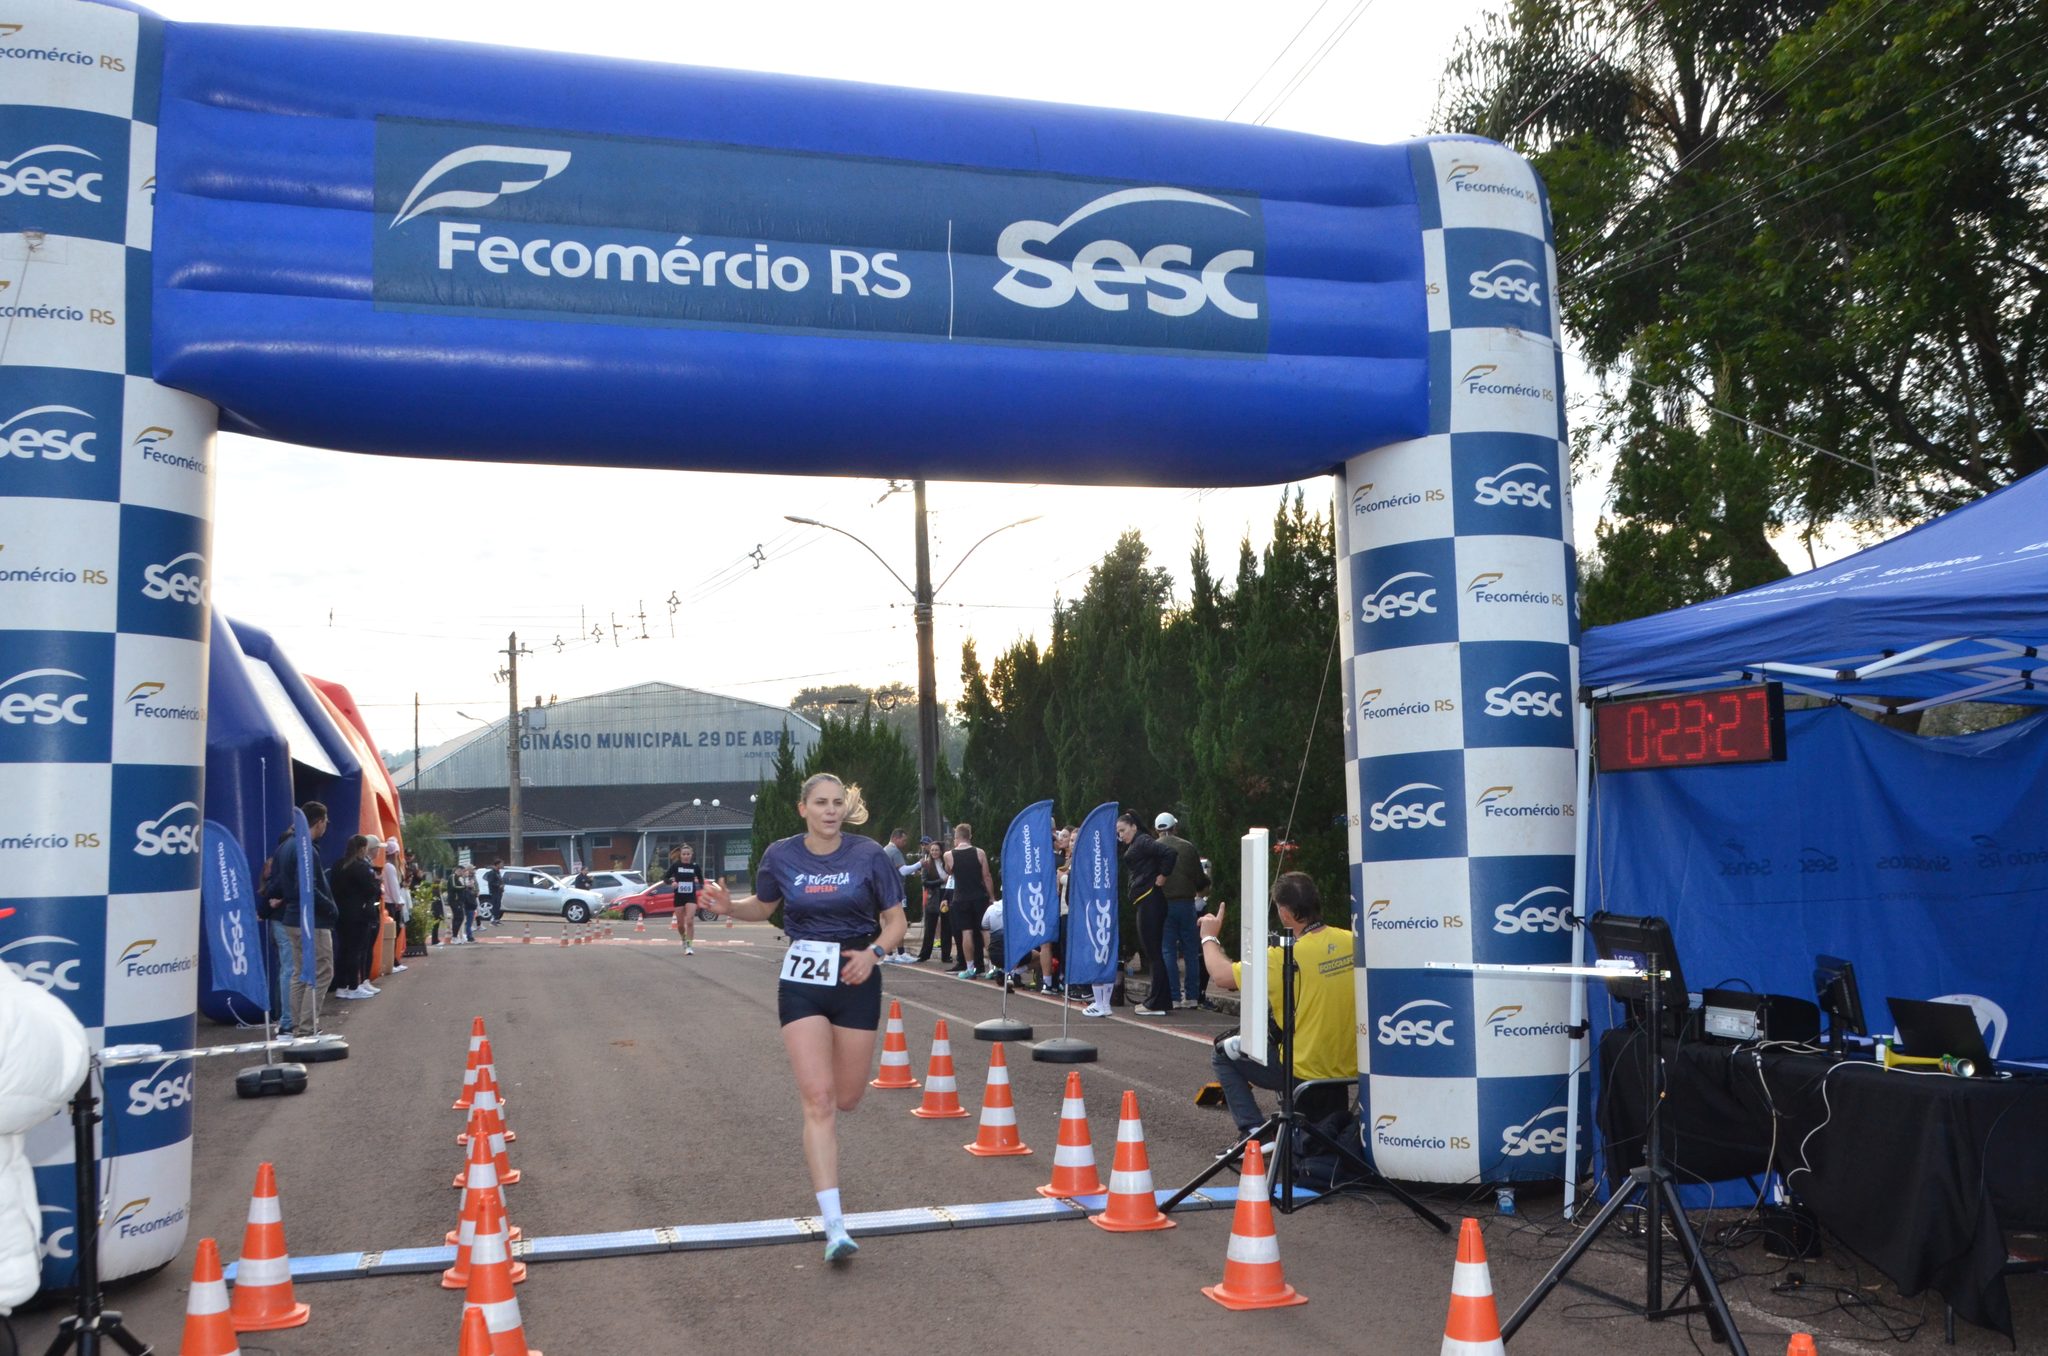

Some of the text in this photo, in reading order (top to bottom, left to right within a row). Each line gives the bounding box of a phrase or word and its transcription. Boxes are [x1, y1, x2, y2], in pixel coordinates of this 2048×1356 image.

[0, 47, 126, 72] ecomércio RS
[1455, 180, 1538, 204] Fecomércio RS
[439, 222, 912, 300] Fecomércio RS
[992, 218, 1260, 320] Sesc
[1469, 269, 1542, 307] Sesc
[0, 303, 116, 326] comércio RS
[1470, 381, 1554, 402] Fecomércio RS
[1355, 486, 1445, 516] Fecomércio RS
[1474, 475, 1552, 510] Sesc
[0, 566, 108, 585] omércio RS
[1361, 587, 1437, 623] Sesc
[1475, 589, 1550, 604] Fecomércio
[1551, 593, 1564, 606] RS
[0, 692, 89, 725] esc
[135, 702, 200, 721] Fecomércio
[1363, 700, 1430, 721] Fecomércio
[1434, 699, 1455, 713] RS
[1483, 686, 1563, 718] Sesc
[520, 729, 801, 750] GINÁSIO MUNICIPAL 29 DE ABRL
[1369, 801, 1447, 832] Sesc
[1485, 802, 1576, 818] Fecomércio RS
[0, 833, 101, 849] mércio RS
[1023, 824, 1033, 875] Fecomércio
[1093, 829, 1101, 890] Fecomércio
[1028, 881, 1046, 937] Sesc
[1371, 914, 1439, 931] Fecomércio
[1443, 915, 1464, 929] RS
[228, 909, 248, 976] Sesc
[1095, 898, 1111, 965] Sesc
[127, 957, 191, 977] Fecomércio
[790, 954, 831, 981] 724
[1376, 1014, 1455, 1047] Sesc
[1494, 1021, 1570, 1038] Fecomércio
[1378, 1131, 1446, 1150] Fecomércio
[1450, 1136, 1471, 1150] RS
[120, 1207, 185, 1239] Fecomércio
